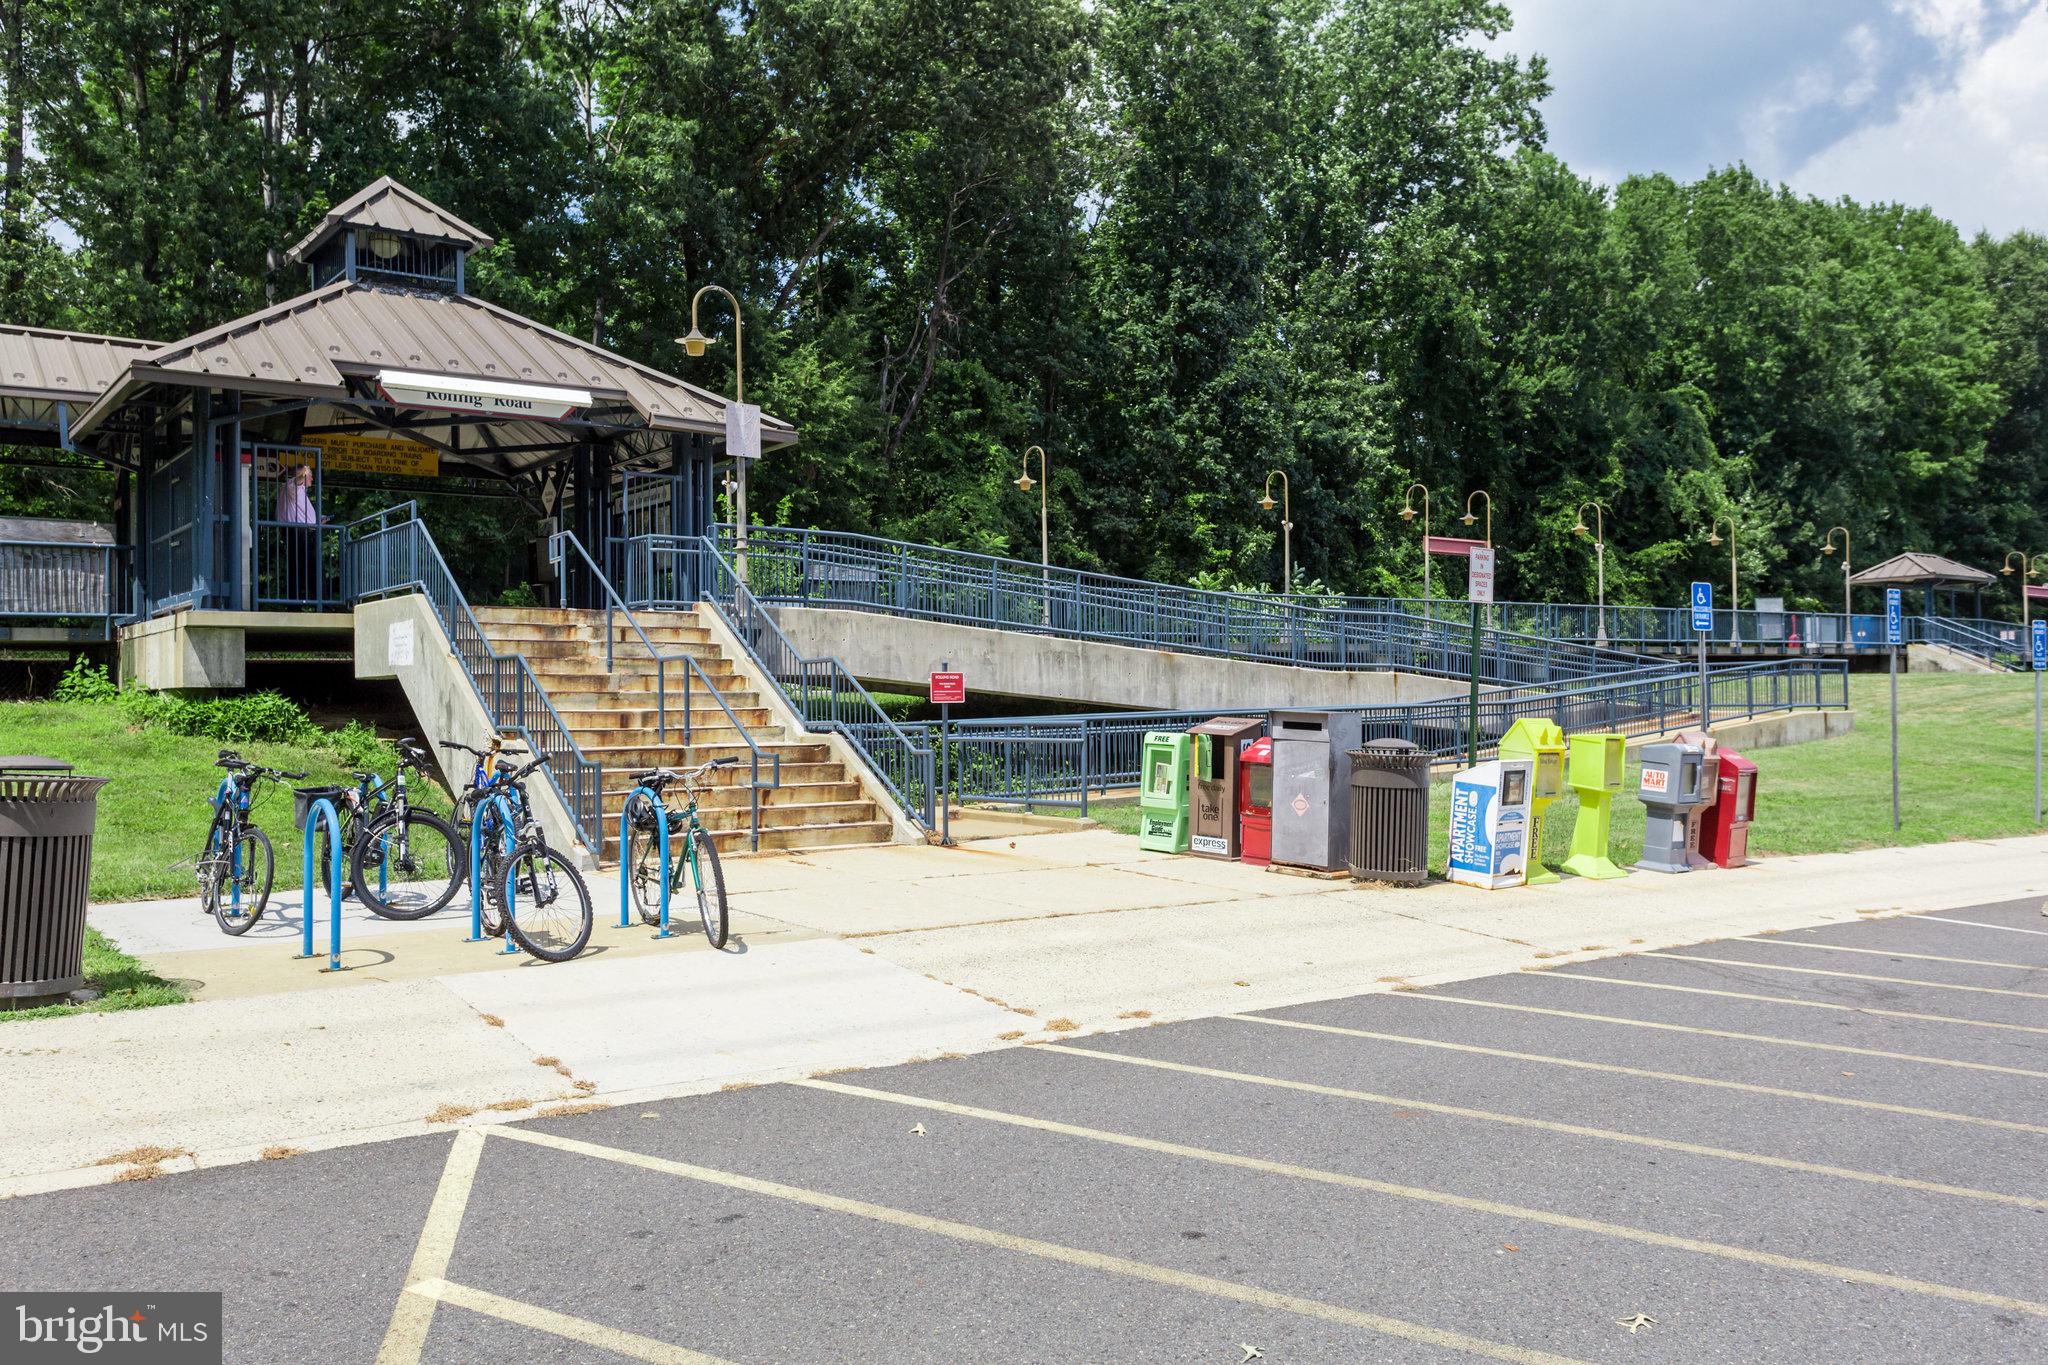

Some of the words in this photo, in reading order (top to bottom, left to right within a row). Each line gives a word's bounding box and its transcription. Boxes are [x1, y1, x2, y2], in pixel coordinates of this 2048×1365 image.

[331, 439, 349, 447] MUST
[353, 441, 386, 450] PURCHASE
[391, 443, 403, 451] AND
[407, 445, 435, 454] VALIDATE
[363, 449, 397, 458] BOARDING
[400, 452, 423, 460] TRAINS
[374, 457, 383, 465] TO
[356, 463, 373, 471] THAN
[1154, 735, 1170, 743] FREE
[1645, 770, 1665, 780] AUTO
[1643, 777, 1665, 787] MART
[1201, 803, 1220, 814] take
[1452, 788, 1469, 863] APARTMENT
[1464, 806, 1478, 864] SHOWCASE
[1530, 816, 1541, 860] FREE
[1193, 837, 1226, 849] express
